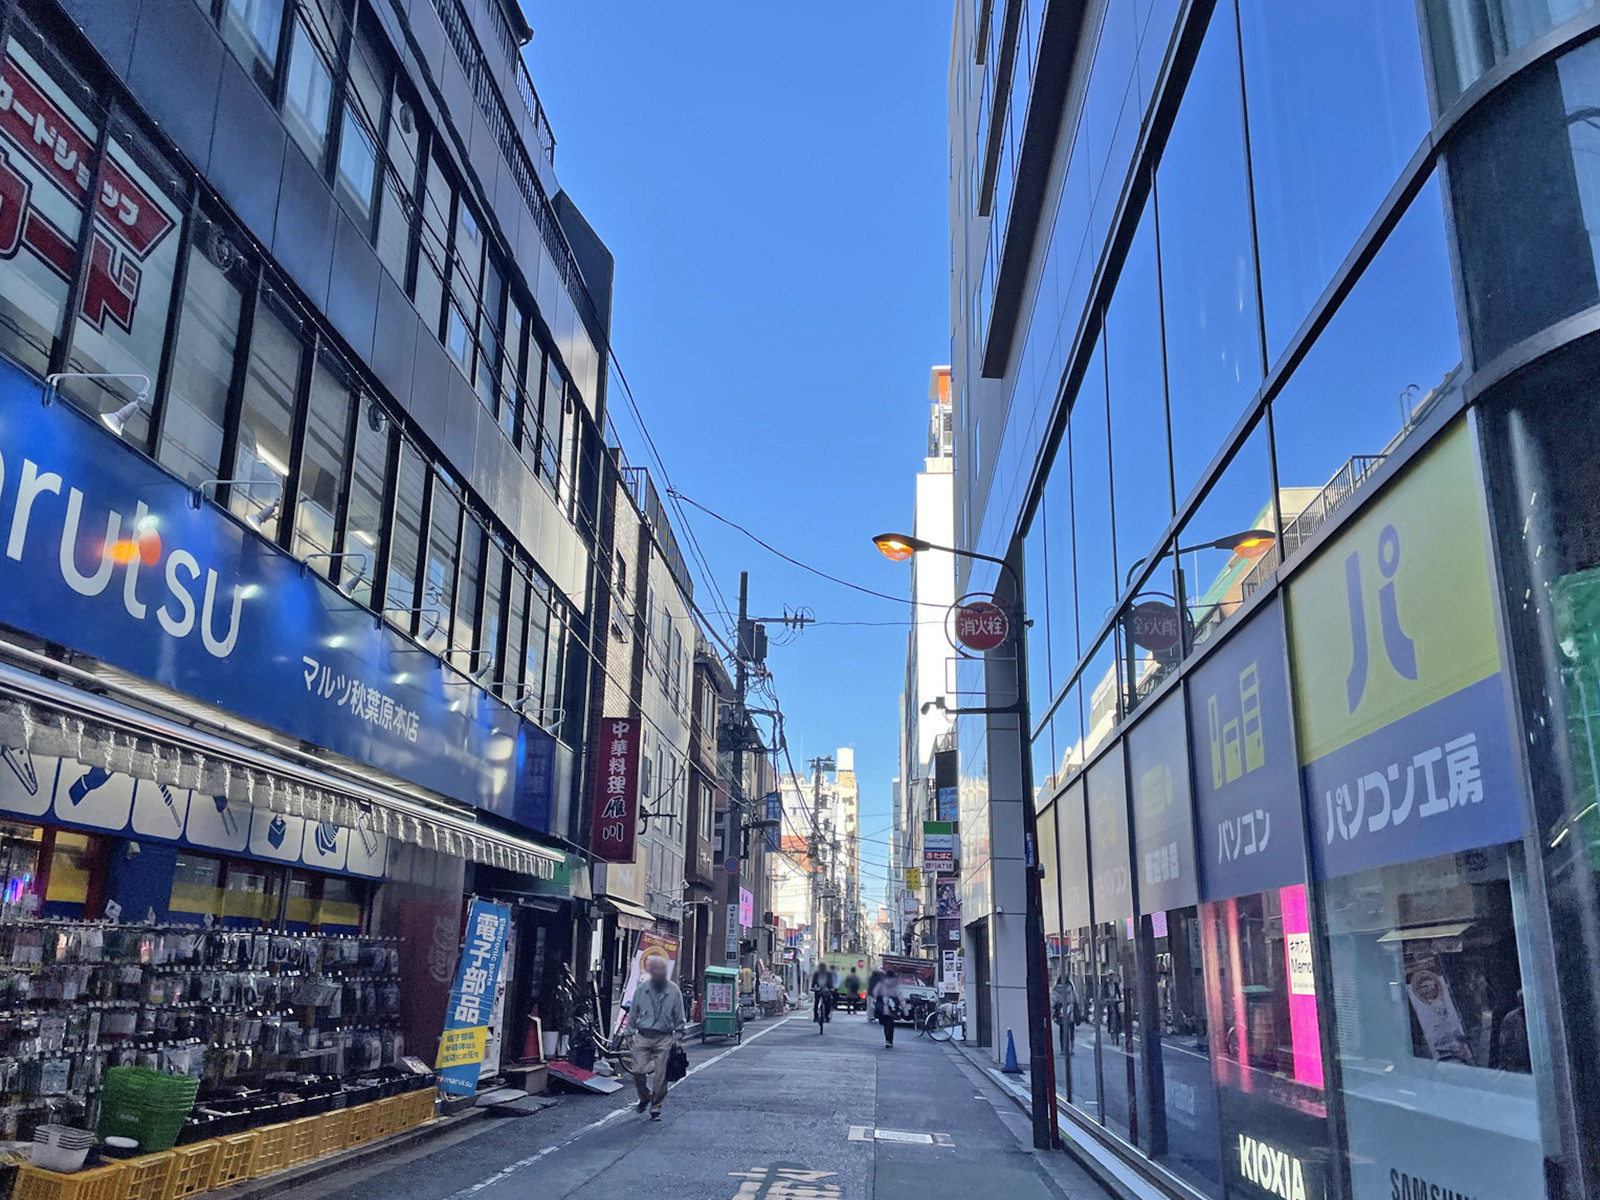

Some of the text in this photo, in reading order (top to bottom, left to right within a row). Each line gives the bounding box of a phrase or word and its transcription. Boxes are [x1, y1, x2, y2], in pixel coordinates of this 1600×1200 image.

[0, 452, 244, 658] rutsu
[960, 616, 1003, 636] 消火栓
[303, 655, 419, 743] マルツ秋葉原本店
[608, 720, 630, 794] 中華料理
[1326, 732, 1484, 845] パソコン工房
[454, 912, 499, 1025] 電子部品
[486, 917, 506, 987] Electronic parts
[444, 1077, 473, 1088] marutsu
[1239, 1133, 1306, 1200] KIOXIA
[1390, 1167, 1478, 1200] SAMS
